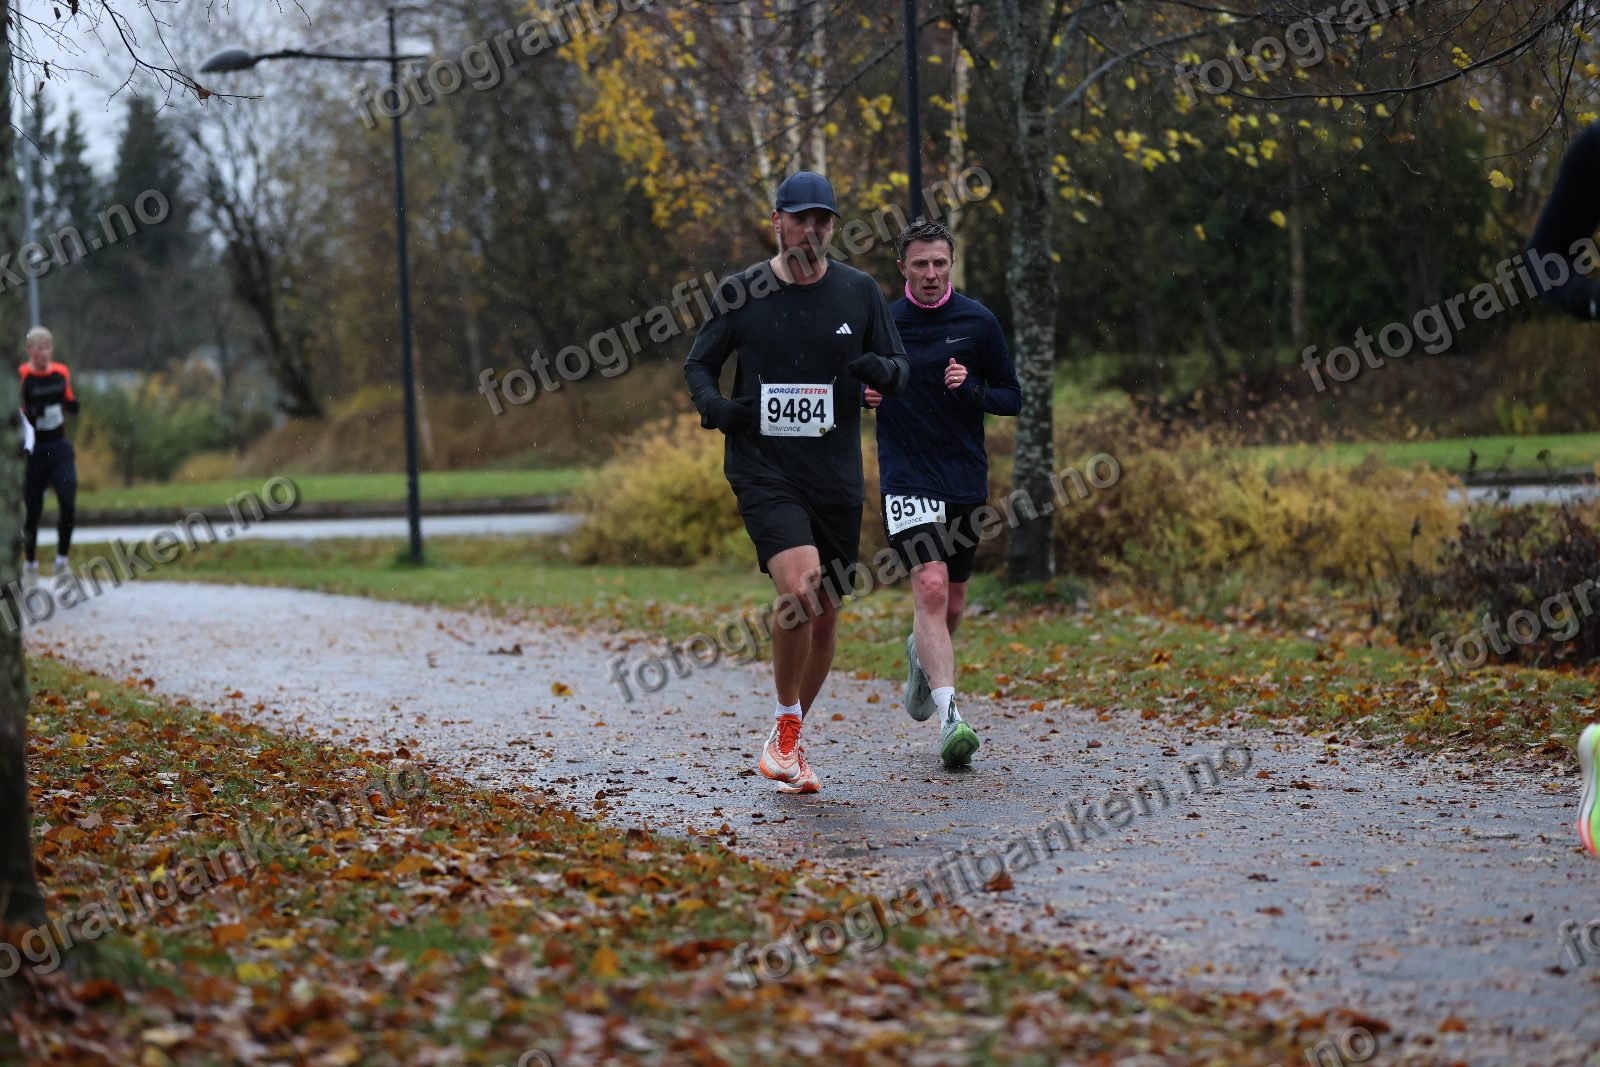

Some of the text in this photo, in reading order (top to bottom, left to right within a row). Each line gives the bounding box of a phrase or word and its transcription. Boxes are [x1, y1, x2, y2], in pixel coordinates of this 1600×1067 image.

[768, 387, 828, 395] NORGESTESTEN
[767, 397, 827, 424] 9484
[890, 496, 940, 522] 9510
